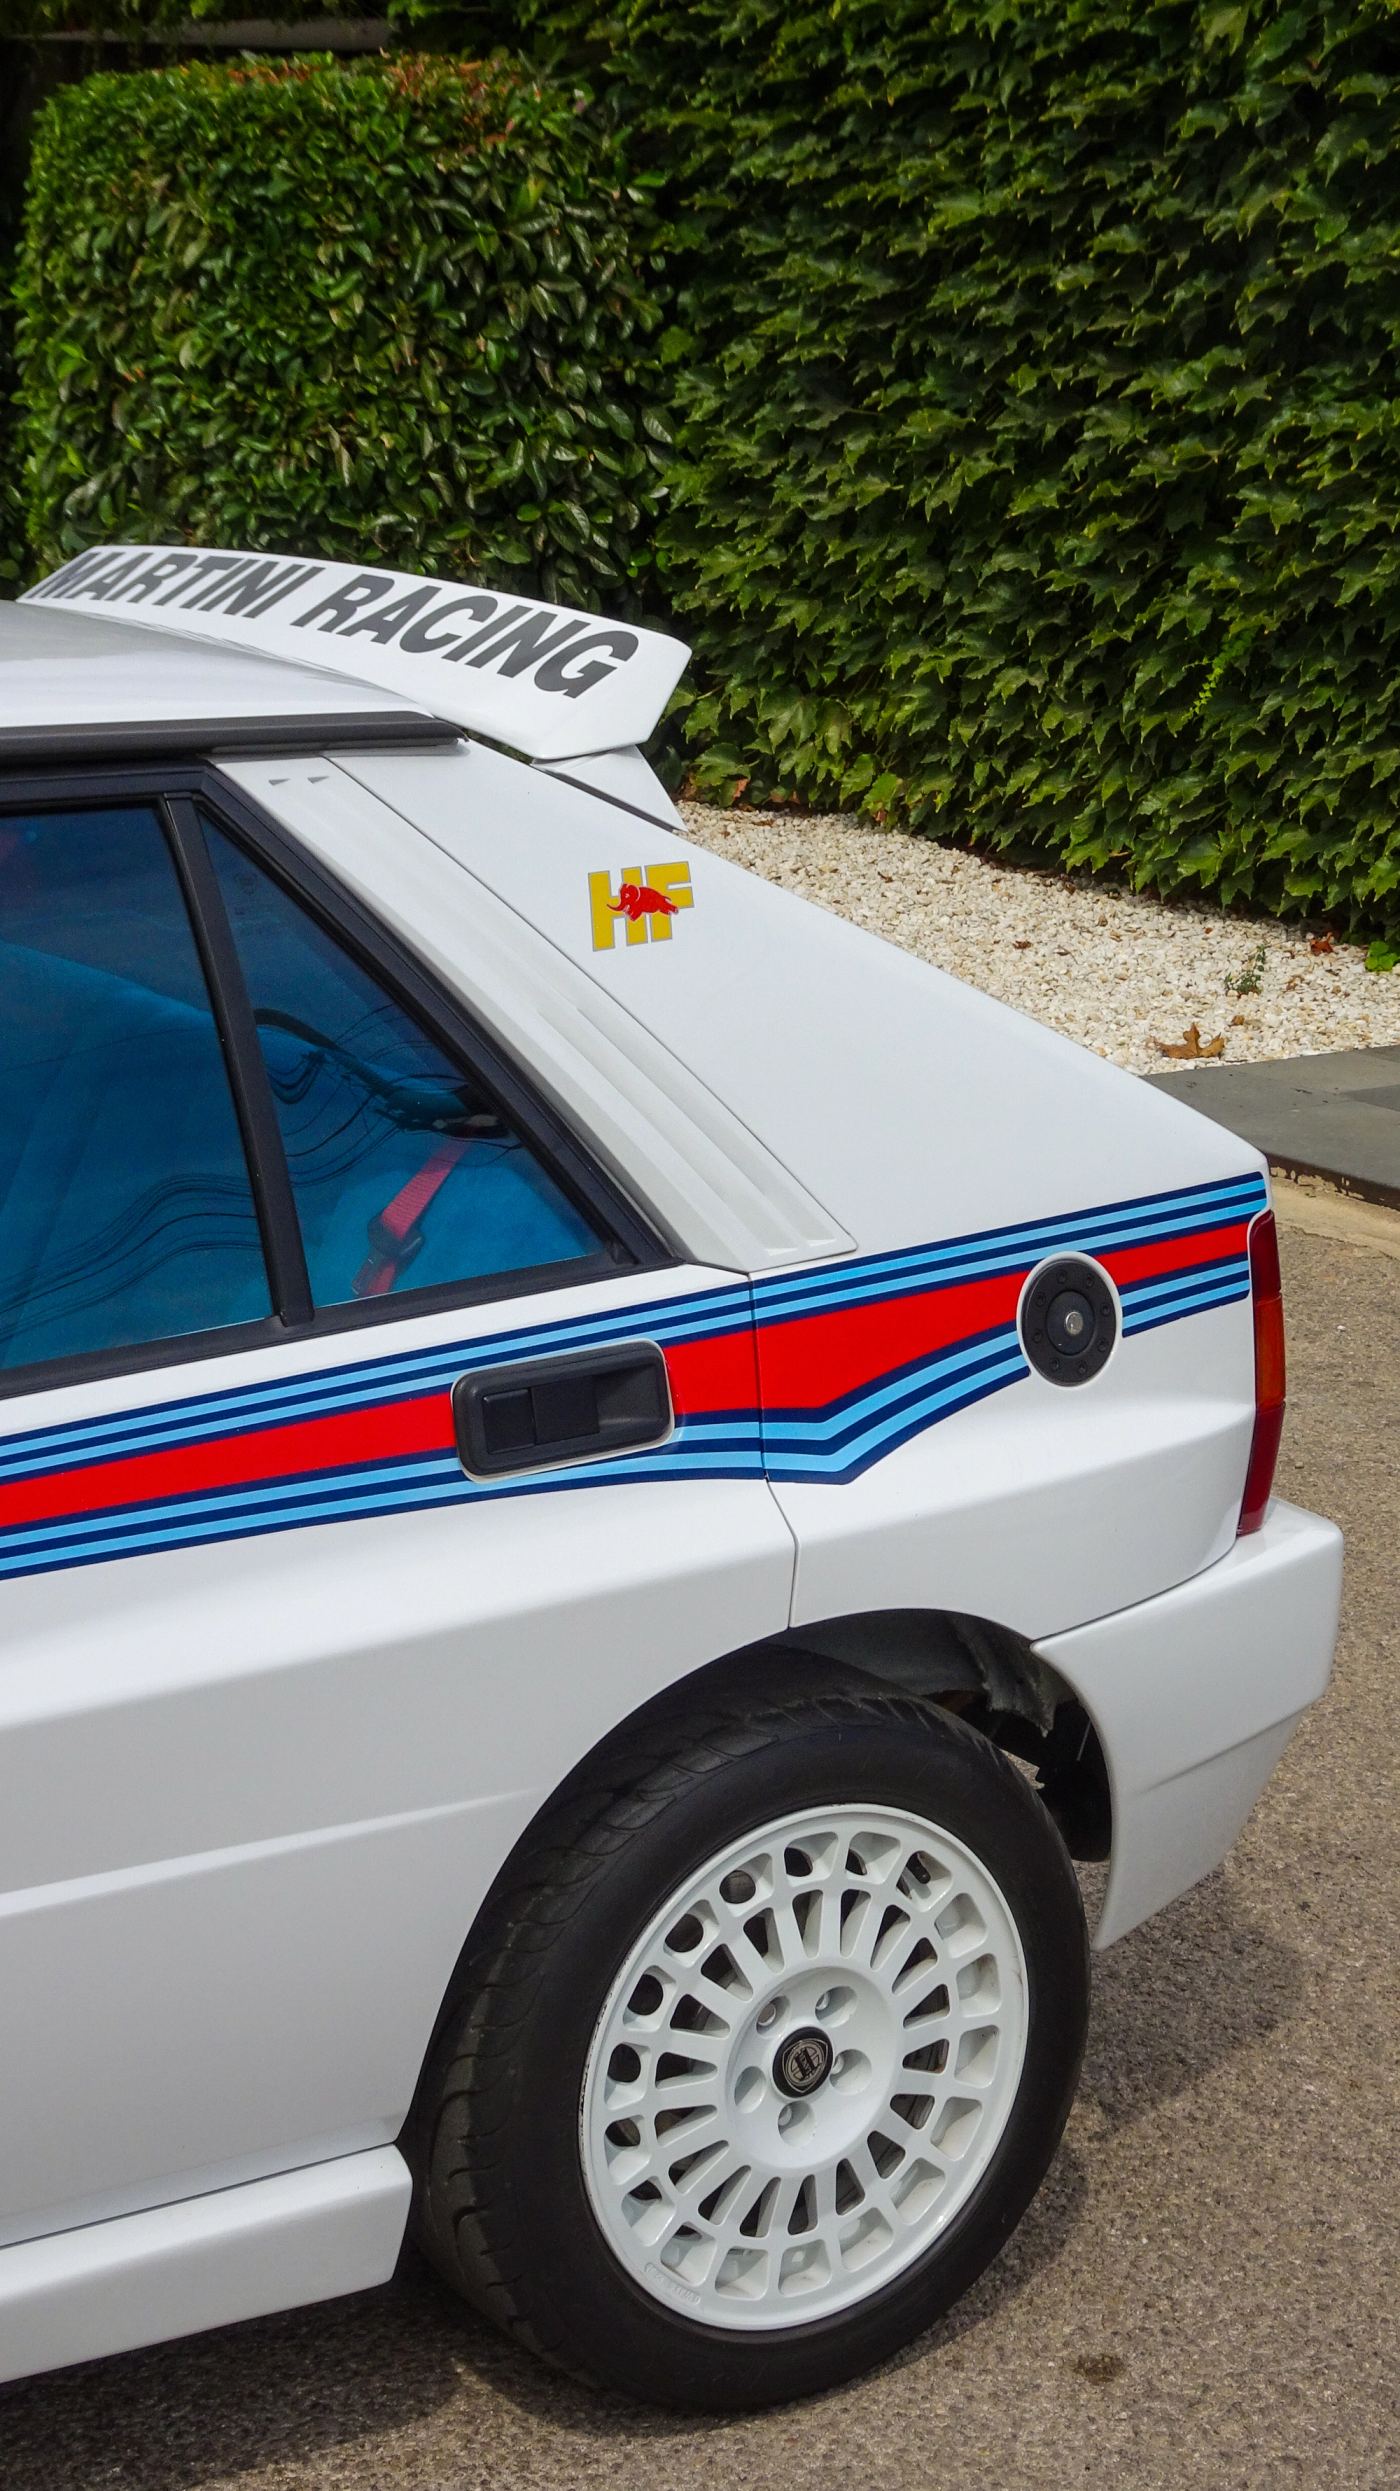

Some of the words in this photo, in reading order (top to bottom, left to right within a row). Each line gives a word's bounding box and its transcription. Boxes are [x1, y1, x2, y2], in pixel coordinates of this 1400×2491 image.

[26, 552, 327, 619] MARTINI
[289, 573, 640, 699] RACING
[587, 860, 695, 952] HF
